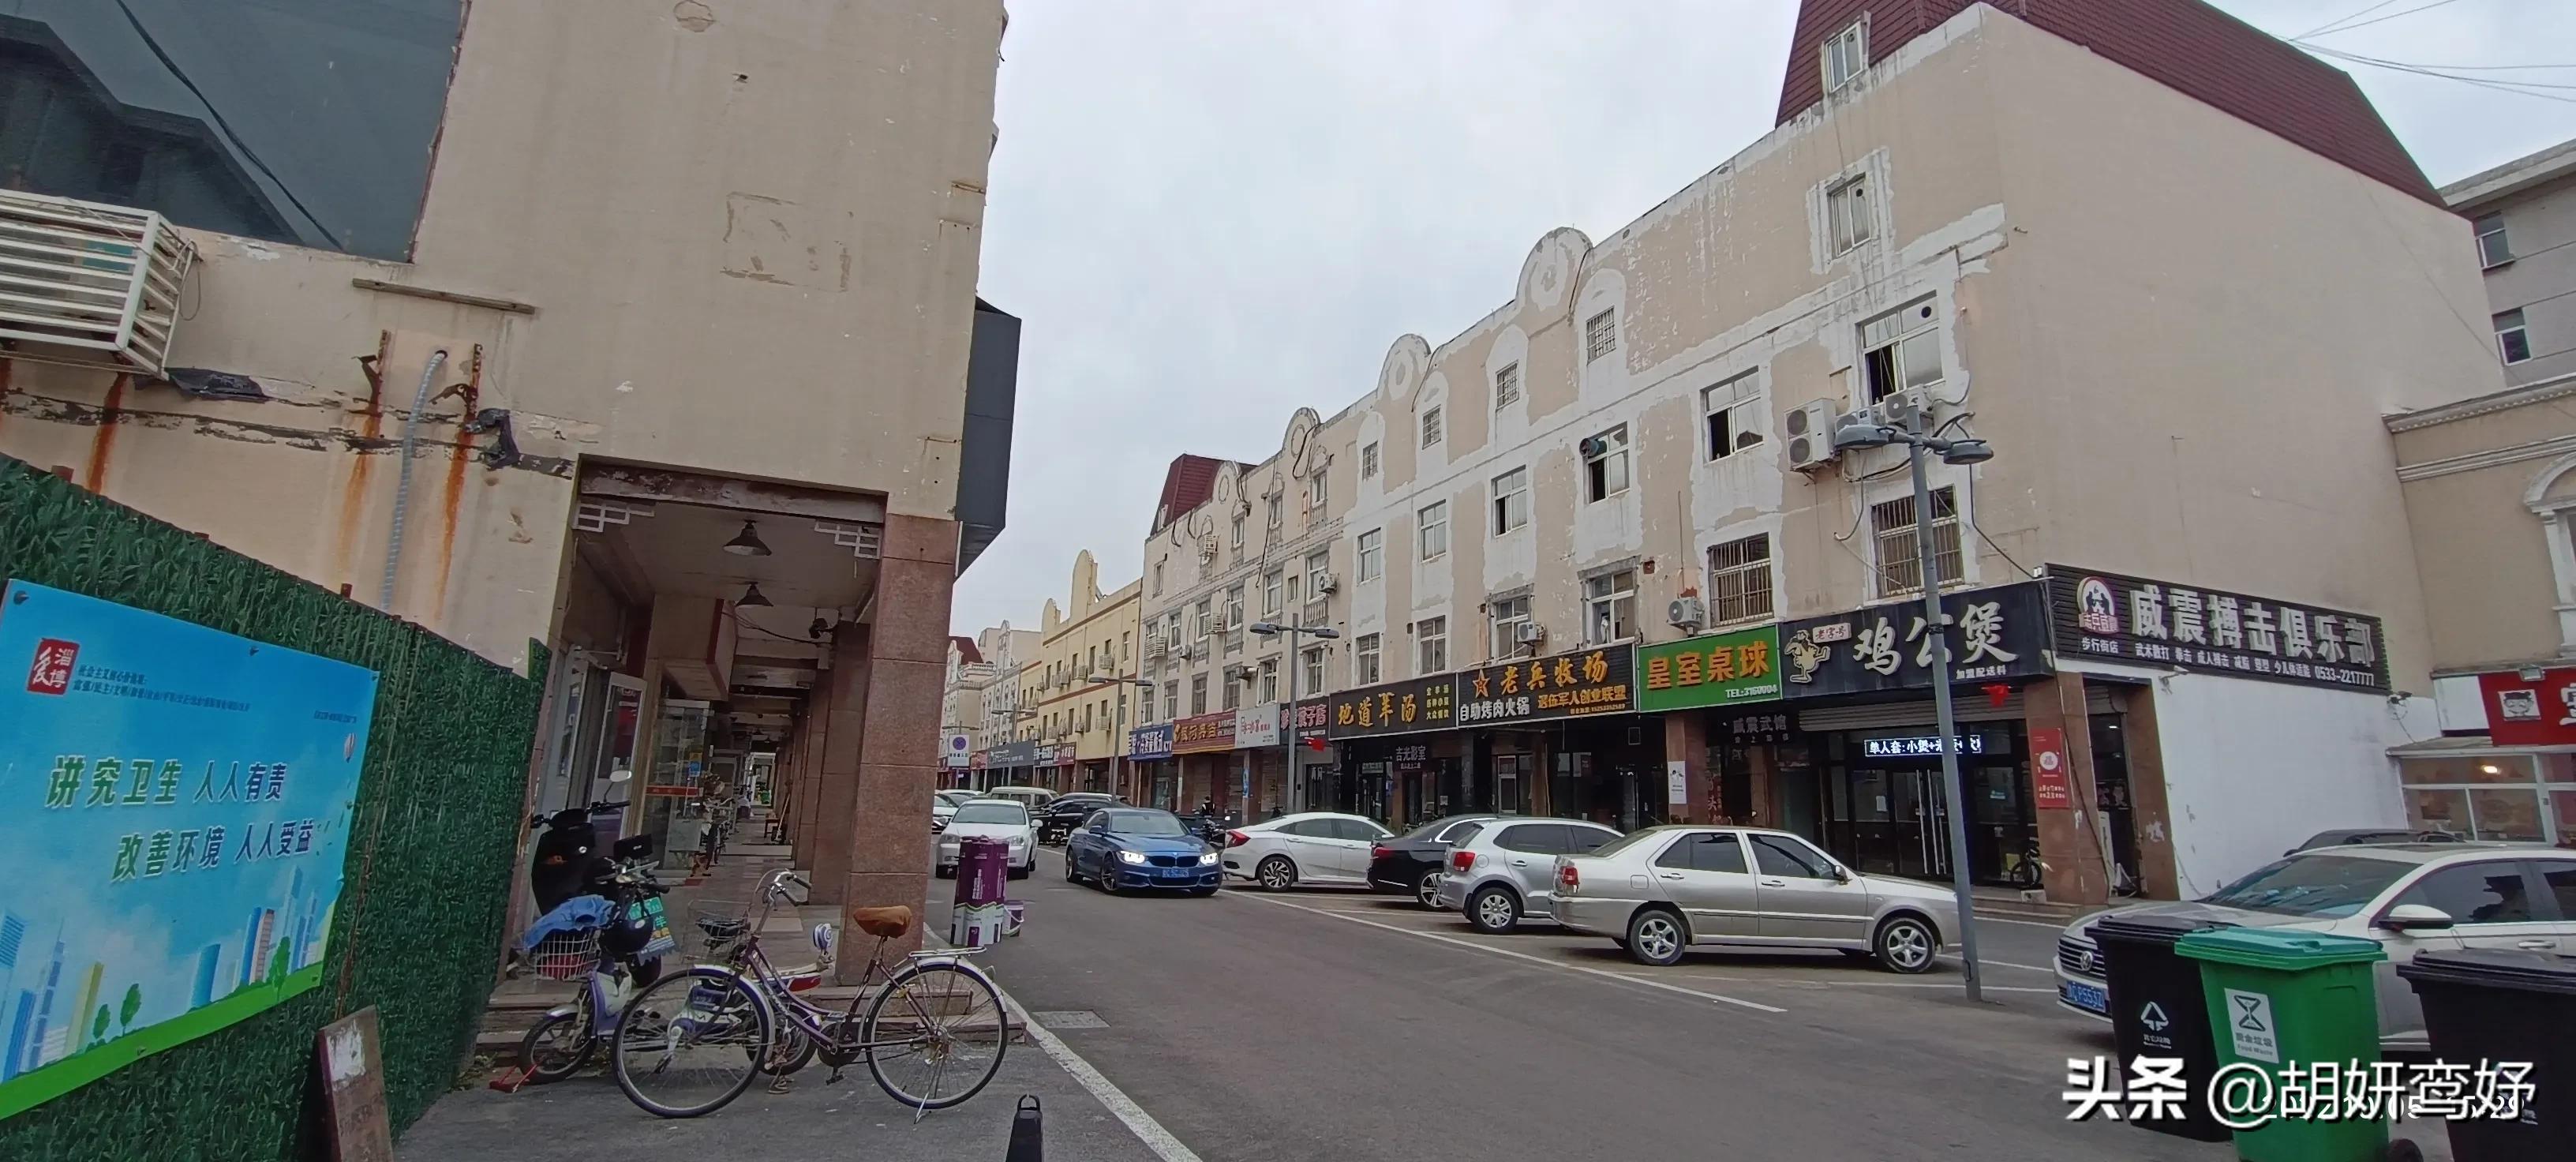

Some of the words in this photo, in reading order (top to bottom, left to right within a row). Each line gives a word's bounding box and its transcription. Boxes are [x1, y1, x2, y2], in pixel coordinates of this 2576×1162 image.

[1815, 626, 1847, 640] 老字号
[1853, 602, 2020, 676] 鸡公煲
[2081, 636, 2119, 654] 步行街店
[2129, 584, 2375, 667] 威震搏击俱乐部
[1500, 650, 1608, 695] 老兵牧场
[1646, 640, 1770, 691] 皇室桌球
[1338, 692, 1417, 727] 地道羊汤
[1460, 696, 1530, 722] 自助烤肉火锅
[44, 754, 182, 810] 讲究卫生
[193, 759, 286, 804] 人人有责
[110, 825, 226, 884] 改善环境
[235, 819, 314, 865] 人人受益
